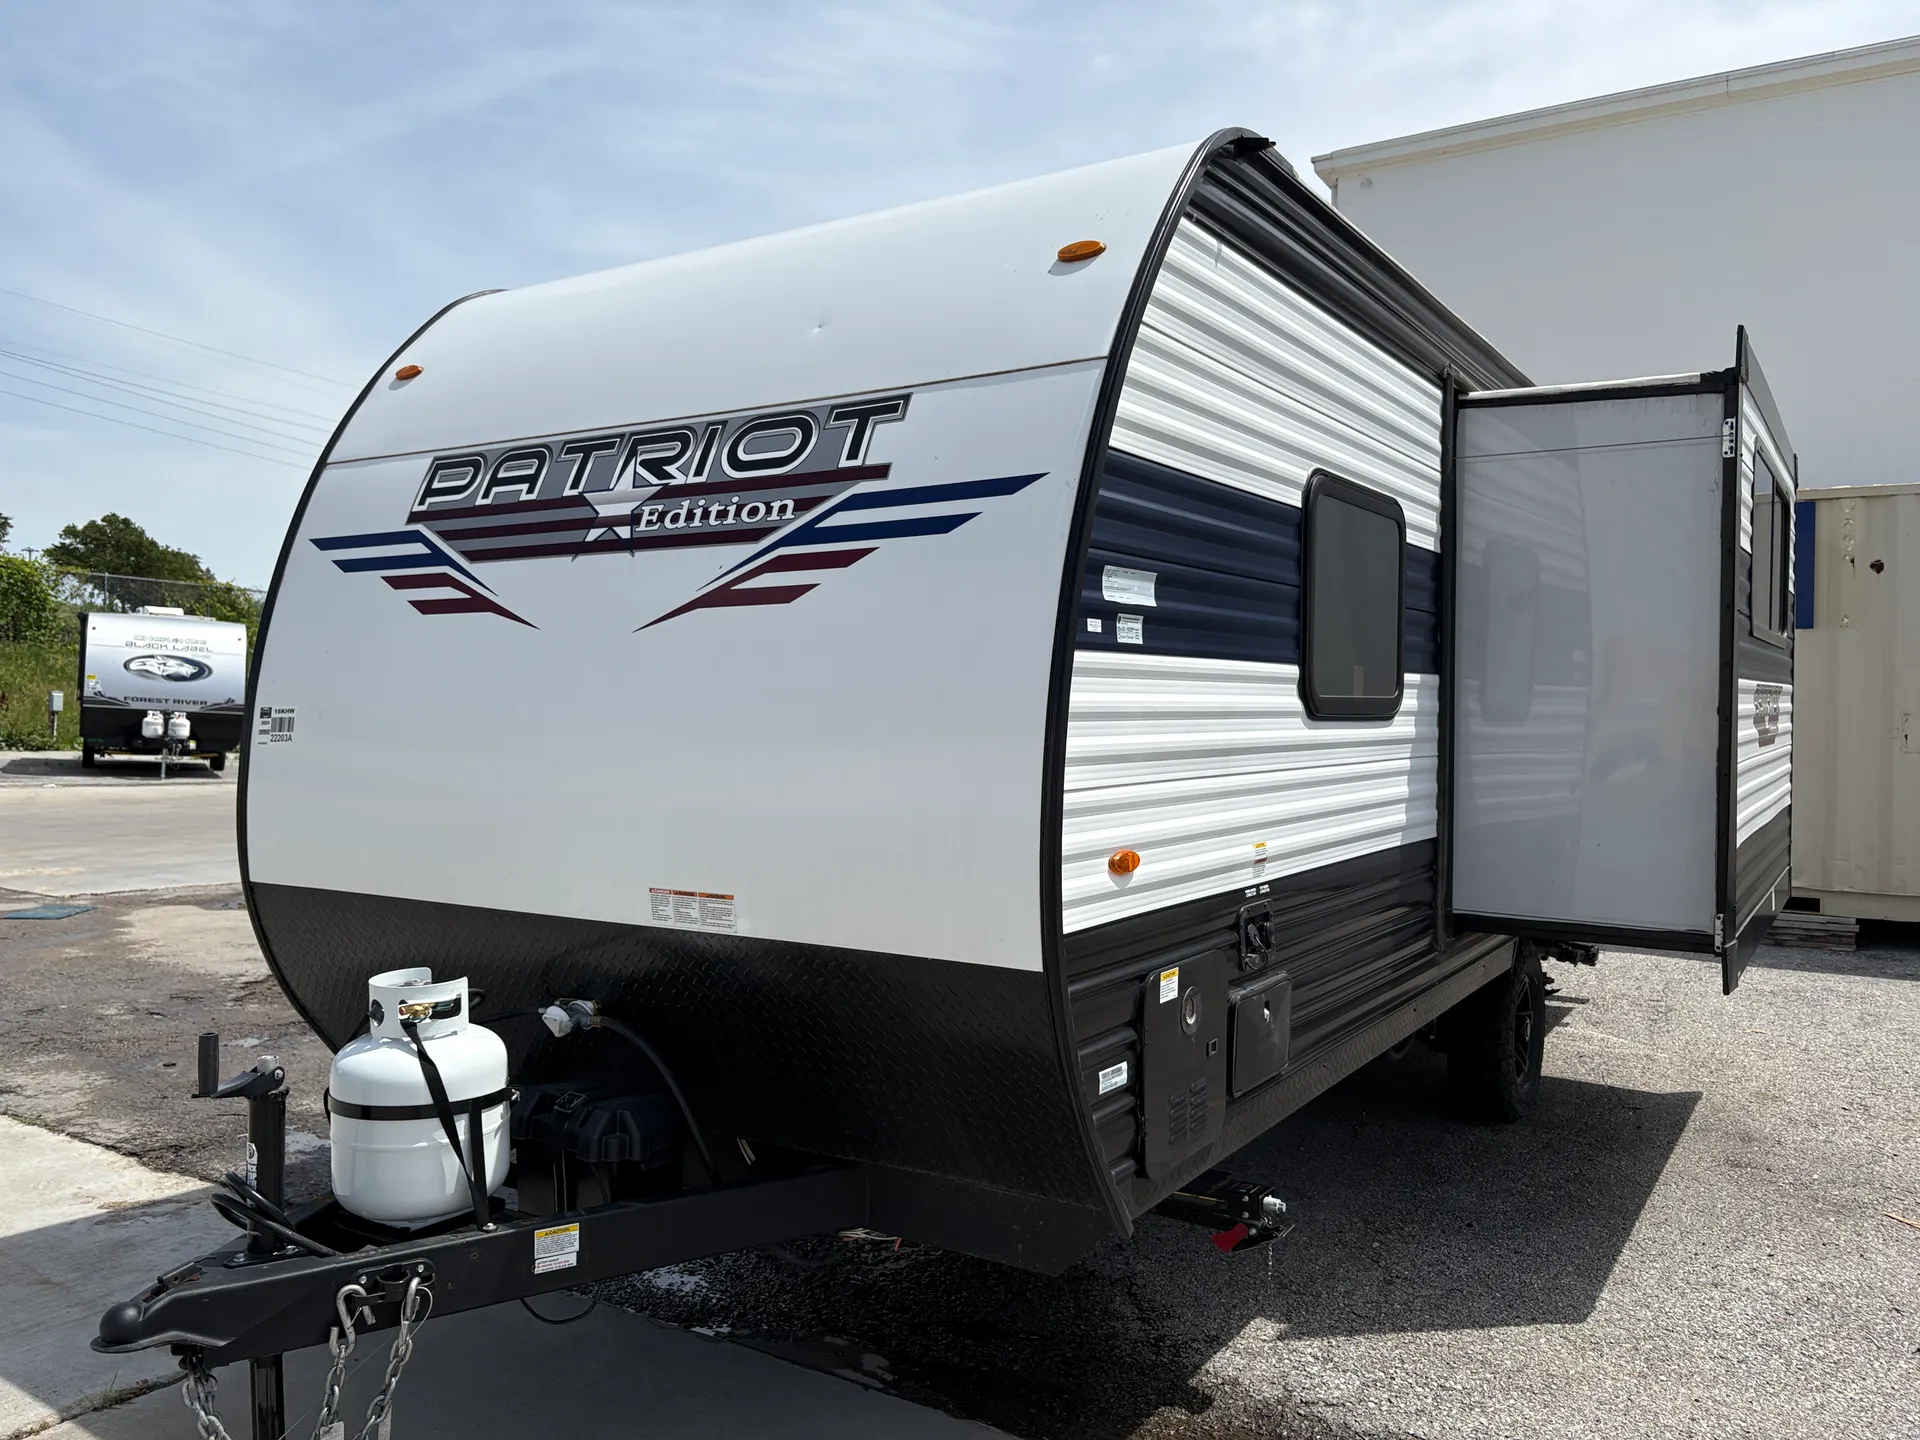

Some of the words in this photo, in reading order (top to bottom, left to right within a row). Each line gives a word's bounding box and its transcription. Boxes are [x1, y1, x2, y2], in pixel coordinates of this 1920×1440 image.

[411, 395, 910, 512] PATRIOT
[635, 495, 796, 532] Edition
[125, 641, 168, 651] BLACK
[173, 644, 213, 653] LABEL
[124, 696, 170, 704] FOREST
[270, 734, 292, 743] 22203A
